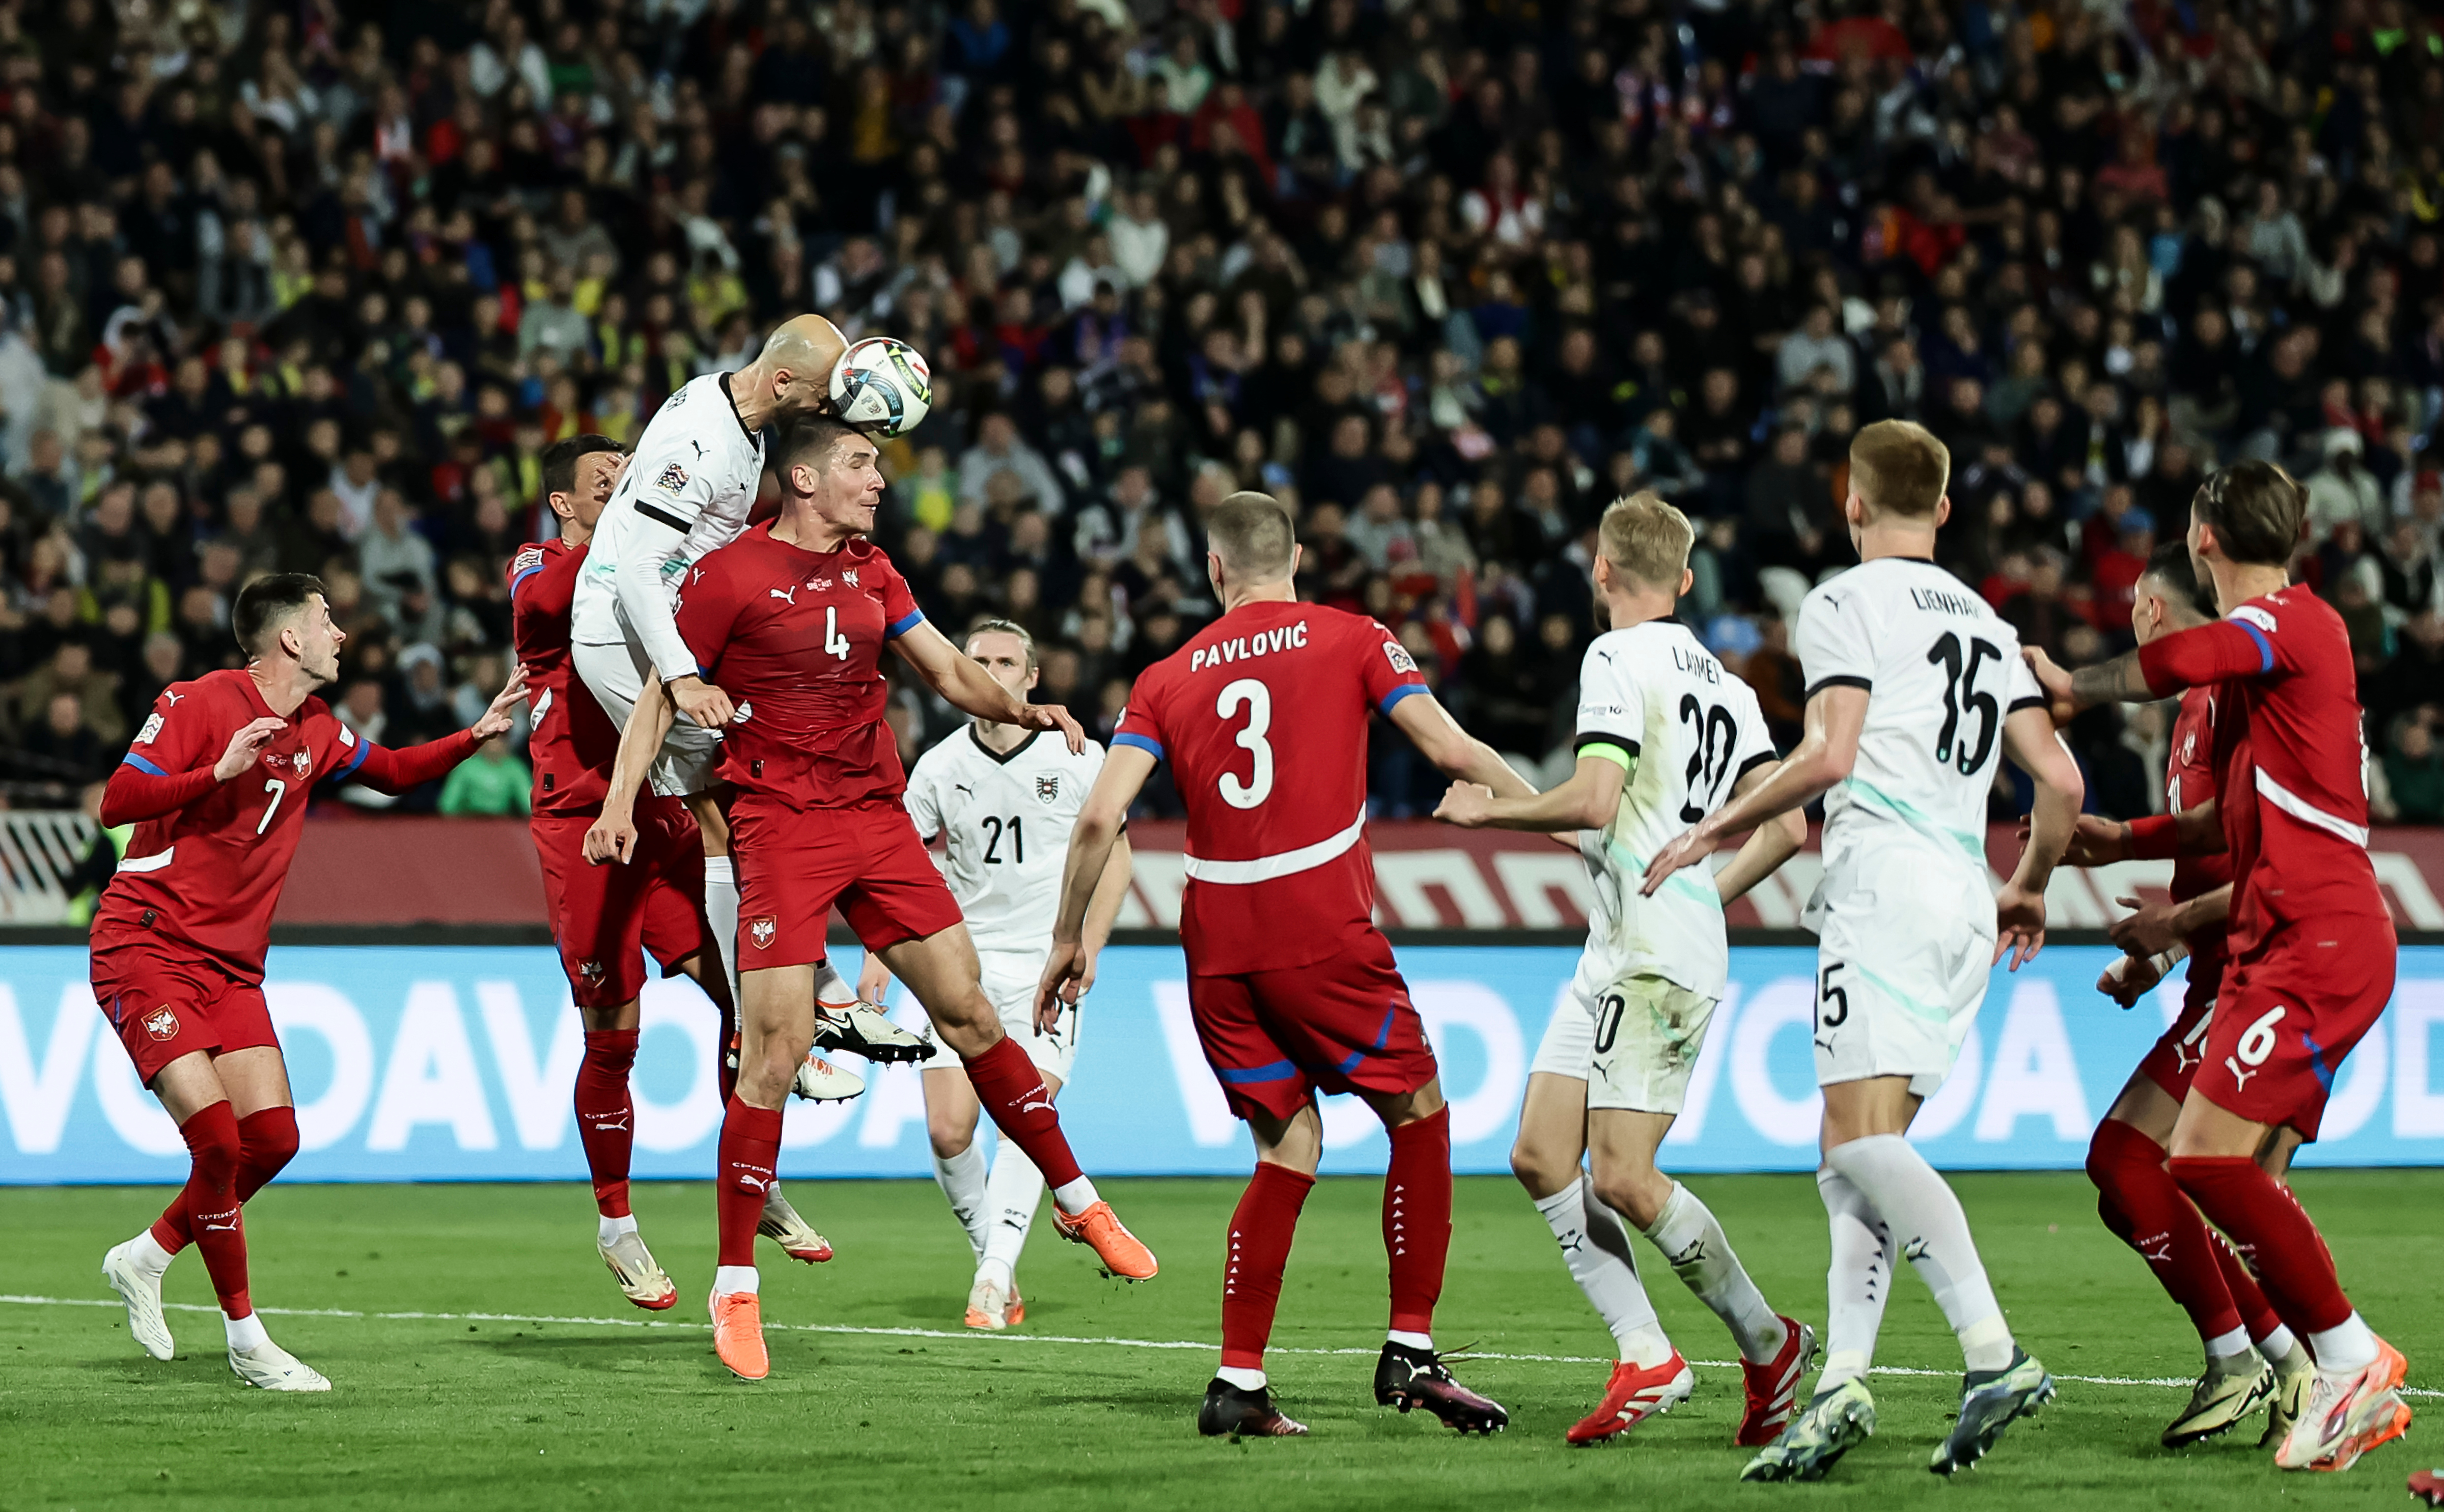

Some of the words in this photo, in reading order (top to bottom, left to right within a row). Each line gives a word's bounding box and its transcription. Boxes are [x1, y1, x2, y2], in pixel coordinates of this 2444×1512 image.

[825, 606, 850, 660] 4
[1909, 586, 1979, 620] LIENHA
[1190, 620, 1309, 673] PAVLOVIĆ
[1927, 631, 2002, 776] 15
[1216, 679, 1274, 809] 3
[1679, 693, 1737, 823] 20
[258, 779, 286, 834] 7
[982, 815, 1022, 864] 21
[1594, 994, 1625, 1054] 0
[1814, 962, 1848, 1034] 5
[2237, 1004, 2287, 1067] 6
